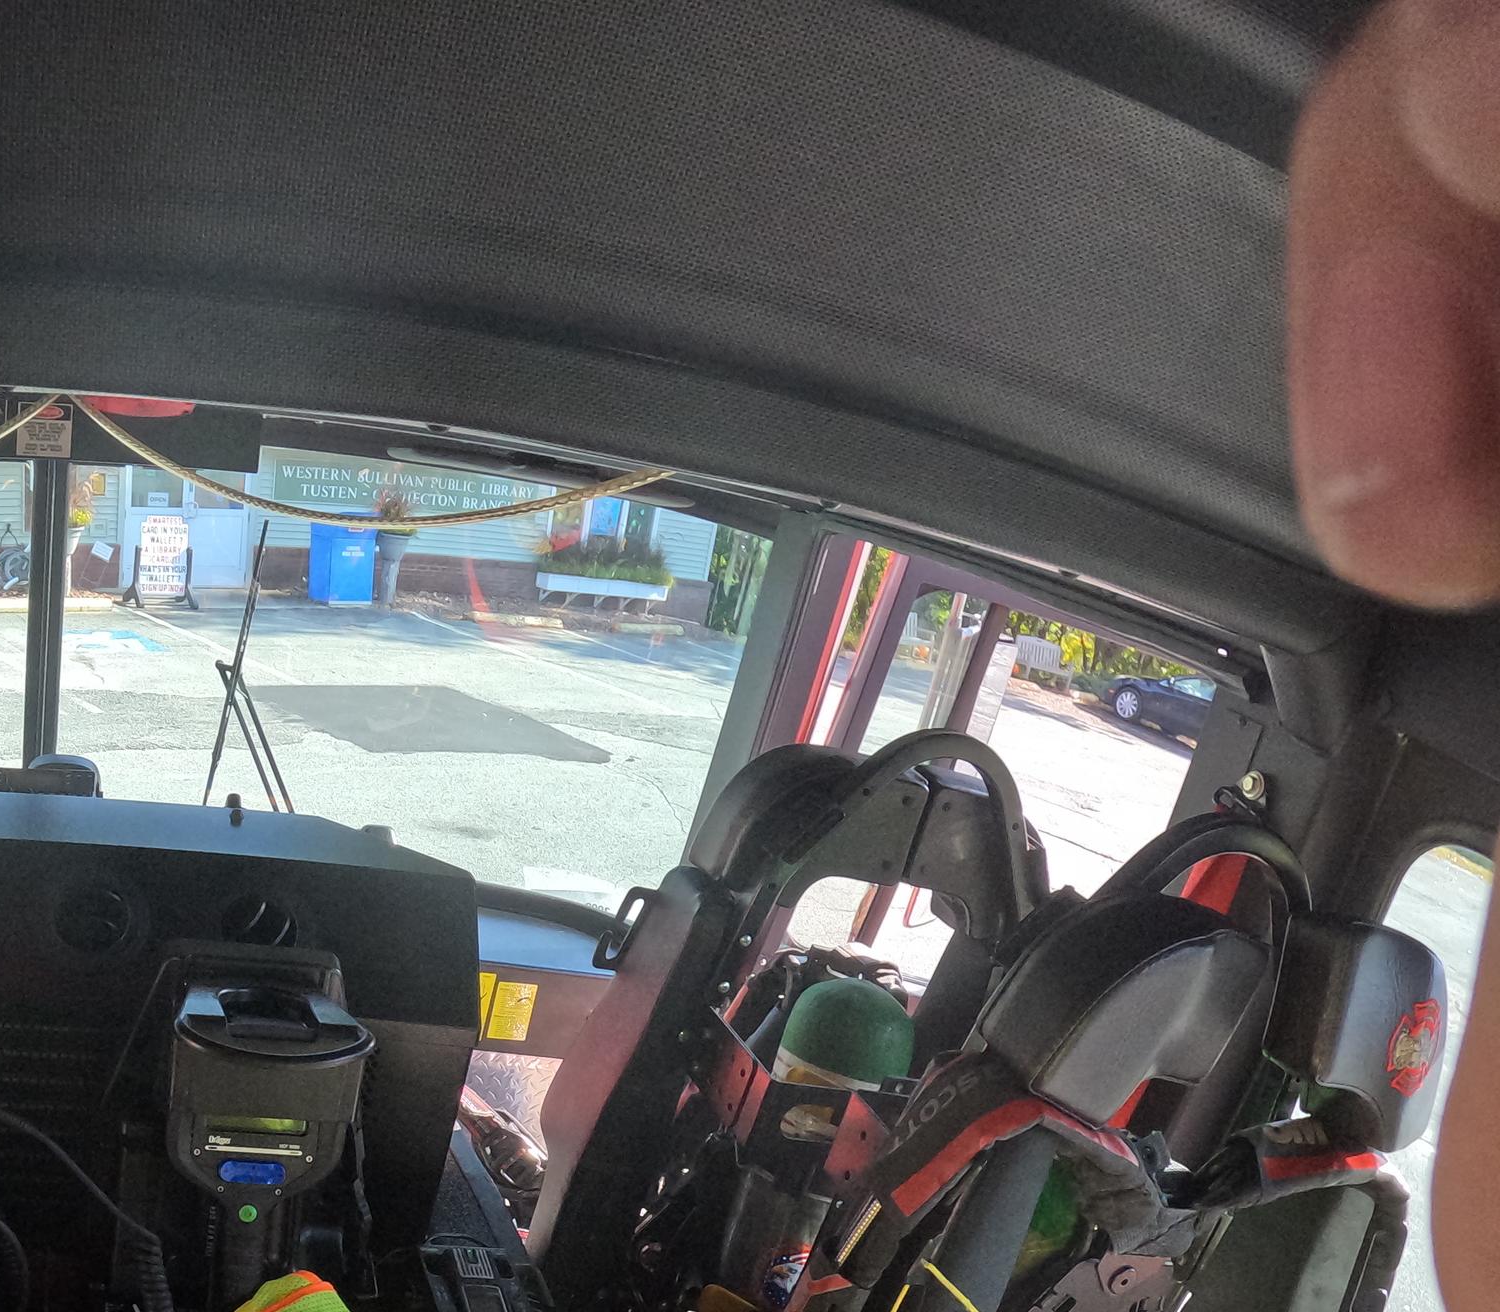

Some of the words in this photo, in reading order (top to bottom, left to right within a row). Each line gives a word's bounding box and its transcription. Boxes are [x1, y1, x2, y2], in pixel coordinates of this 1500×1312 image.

[282, 465, 351, 481] WESTERN
[357, 468, 424, 488] SULLIVAN
[430, 477, 477, 493] PUBLIC
[481, 482, 534, 499] LIBRARY
[301, 484, 357, 499] TUSTEN
[148, 517, 182, 525] SMARTEST
[142, 526, 159, 534] CARD
[150, 536, 176, 545] WALLET
[171, 565, 186, 573] YOUR
[141, 583, 157, 591] SIGN
